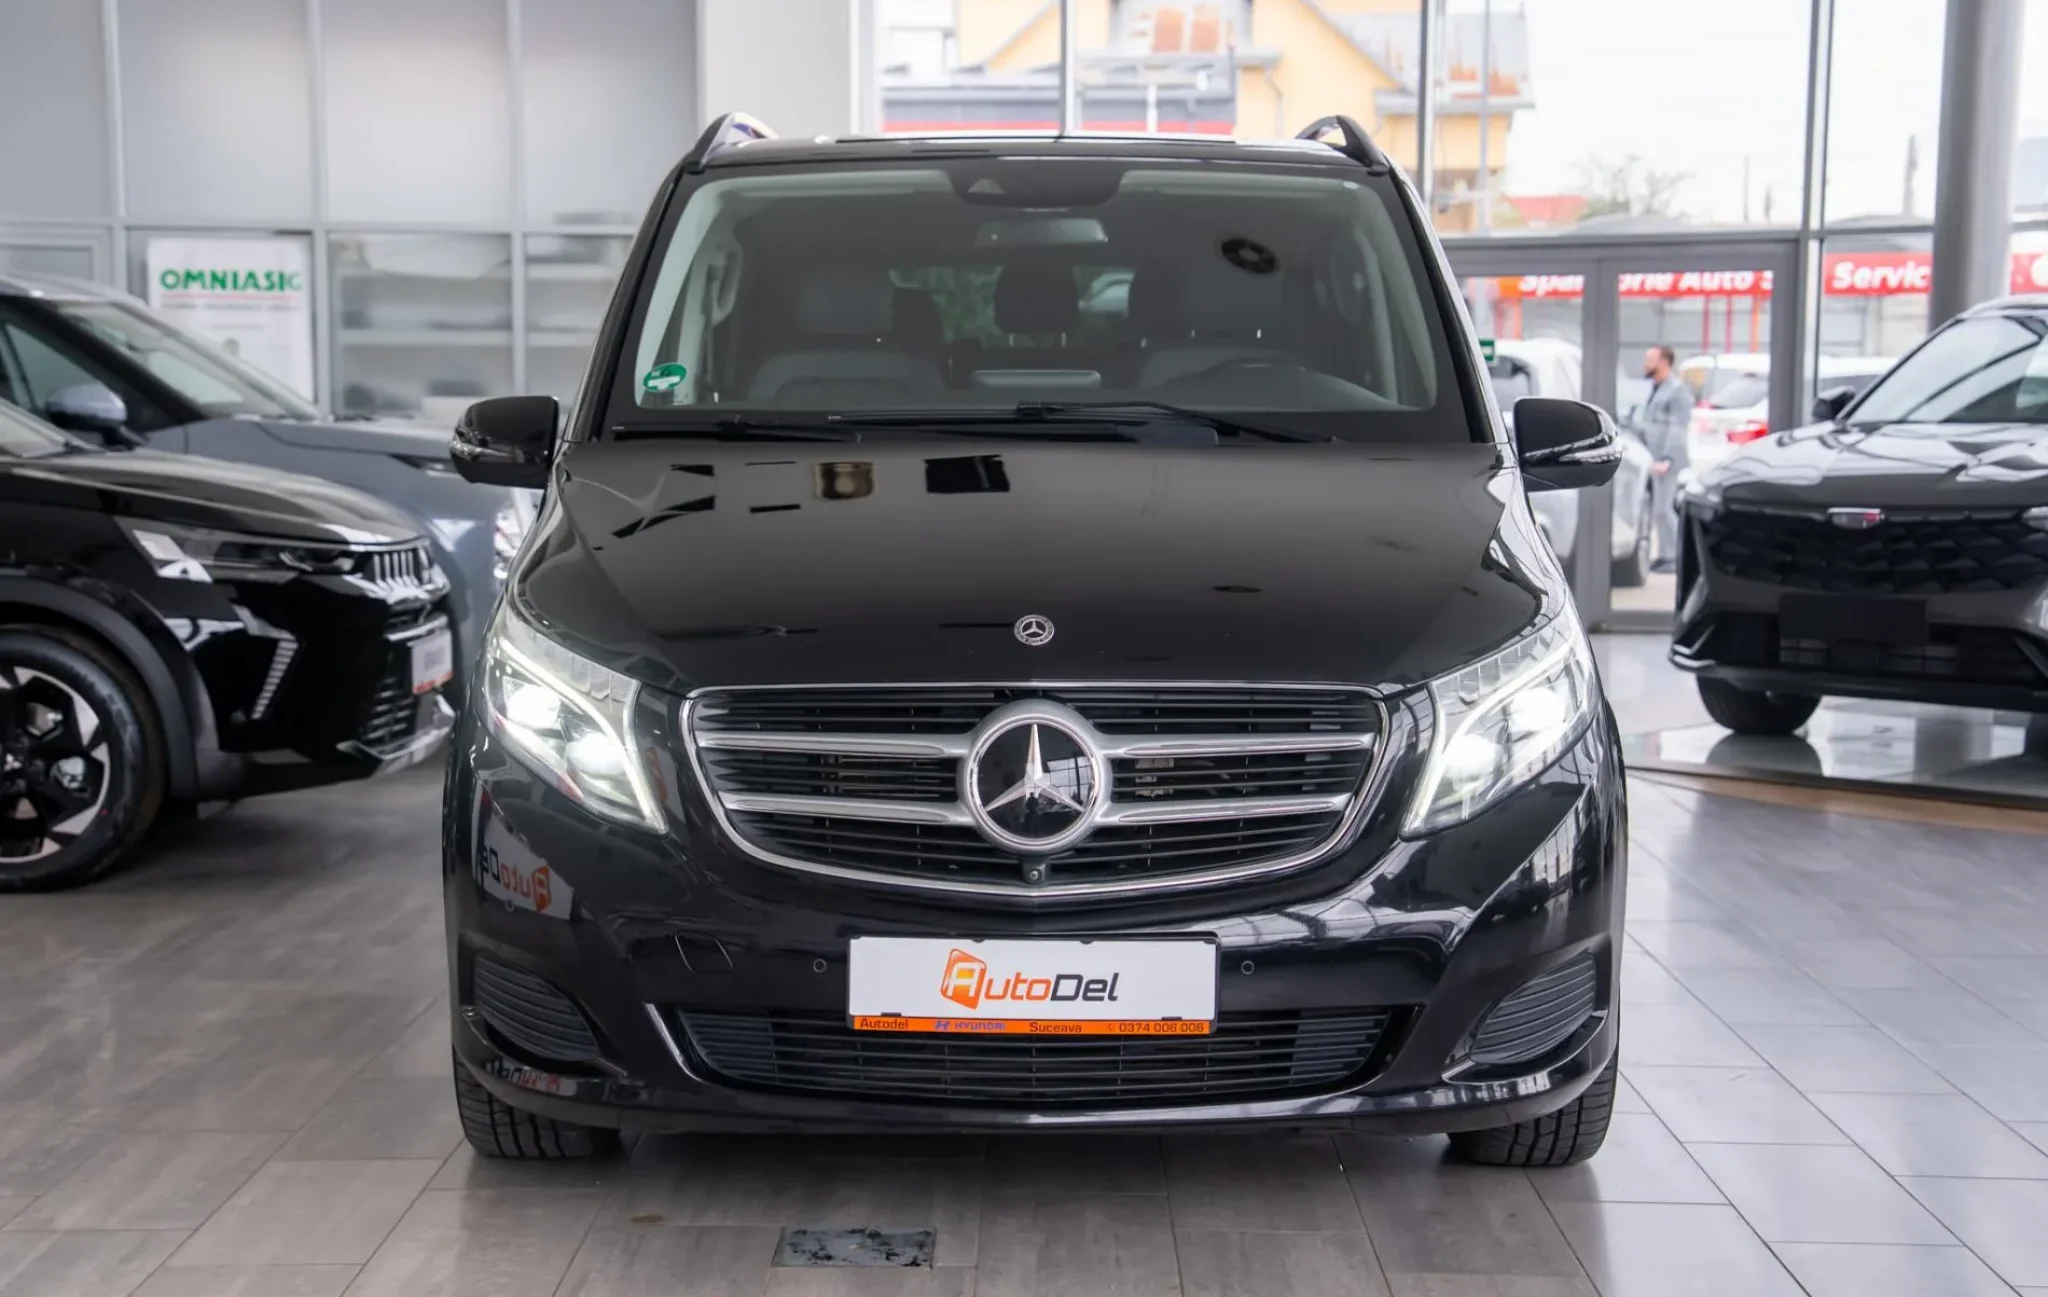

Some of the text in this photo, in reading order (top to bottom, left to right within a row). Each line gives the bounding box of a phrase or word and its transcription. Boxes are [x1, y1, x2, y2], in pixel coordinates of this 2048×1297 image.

[943, 956, 1120, 1004] AutoDel
[859, 1017, 909, 1030] Autodel
[1029, 1021, 1082, 1033] Suceava
[1118, 1022, 1150, 1033] 0374
